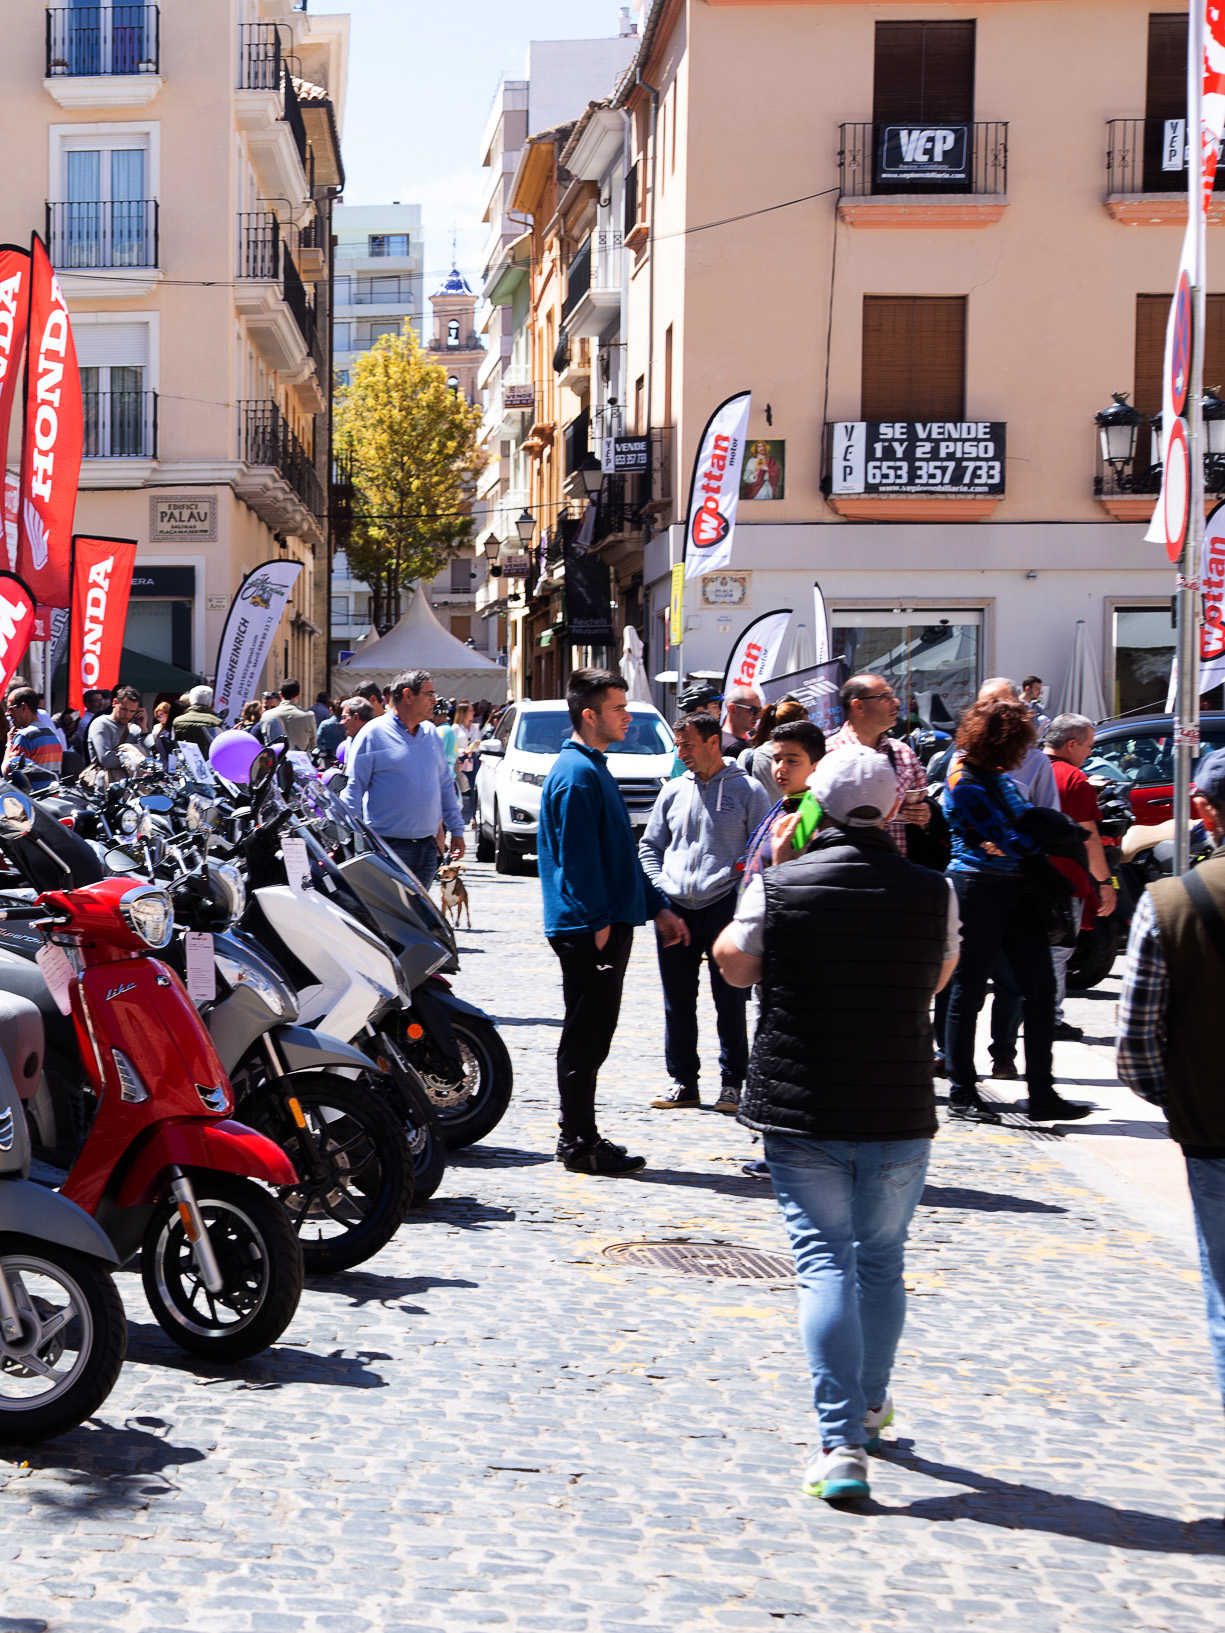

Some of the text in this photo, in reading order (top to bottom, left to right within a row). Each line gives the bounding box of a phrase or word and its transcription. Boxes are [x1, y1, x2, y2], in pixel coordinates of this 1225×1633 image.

[900, 130, 955, 162] VEP
[1168, 122, 1178, 162] VEP
[879, 422, 990, 438] SE VENDE
[616, 442, 648, 452] VENDE
[729, 438, 738, 466] motor
[844, 425, 854, 482] VEP
[891, 442, 908, 458] Y
[939, 442, 995, 458] PISO
[866, 461, 1001, 484] 653 357 733
[160, 512, 208, 522] PALAU
[80, 555, 114, 688] ONDA
[220, 618, 250, 705] JUNGHEINRICH
[734, 642, 762, 688] tan
